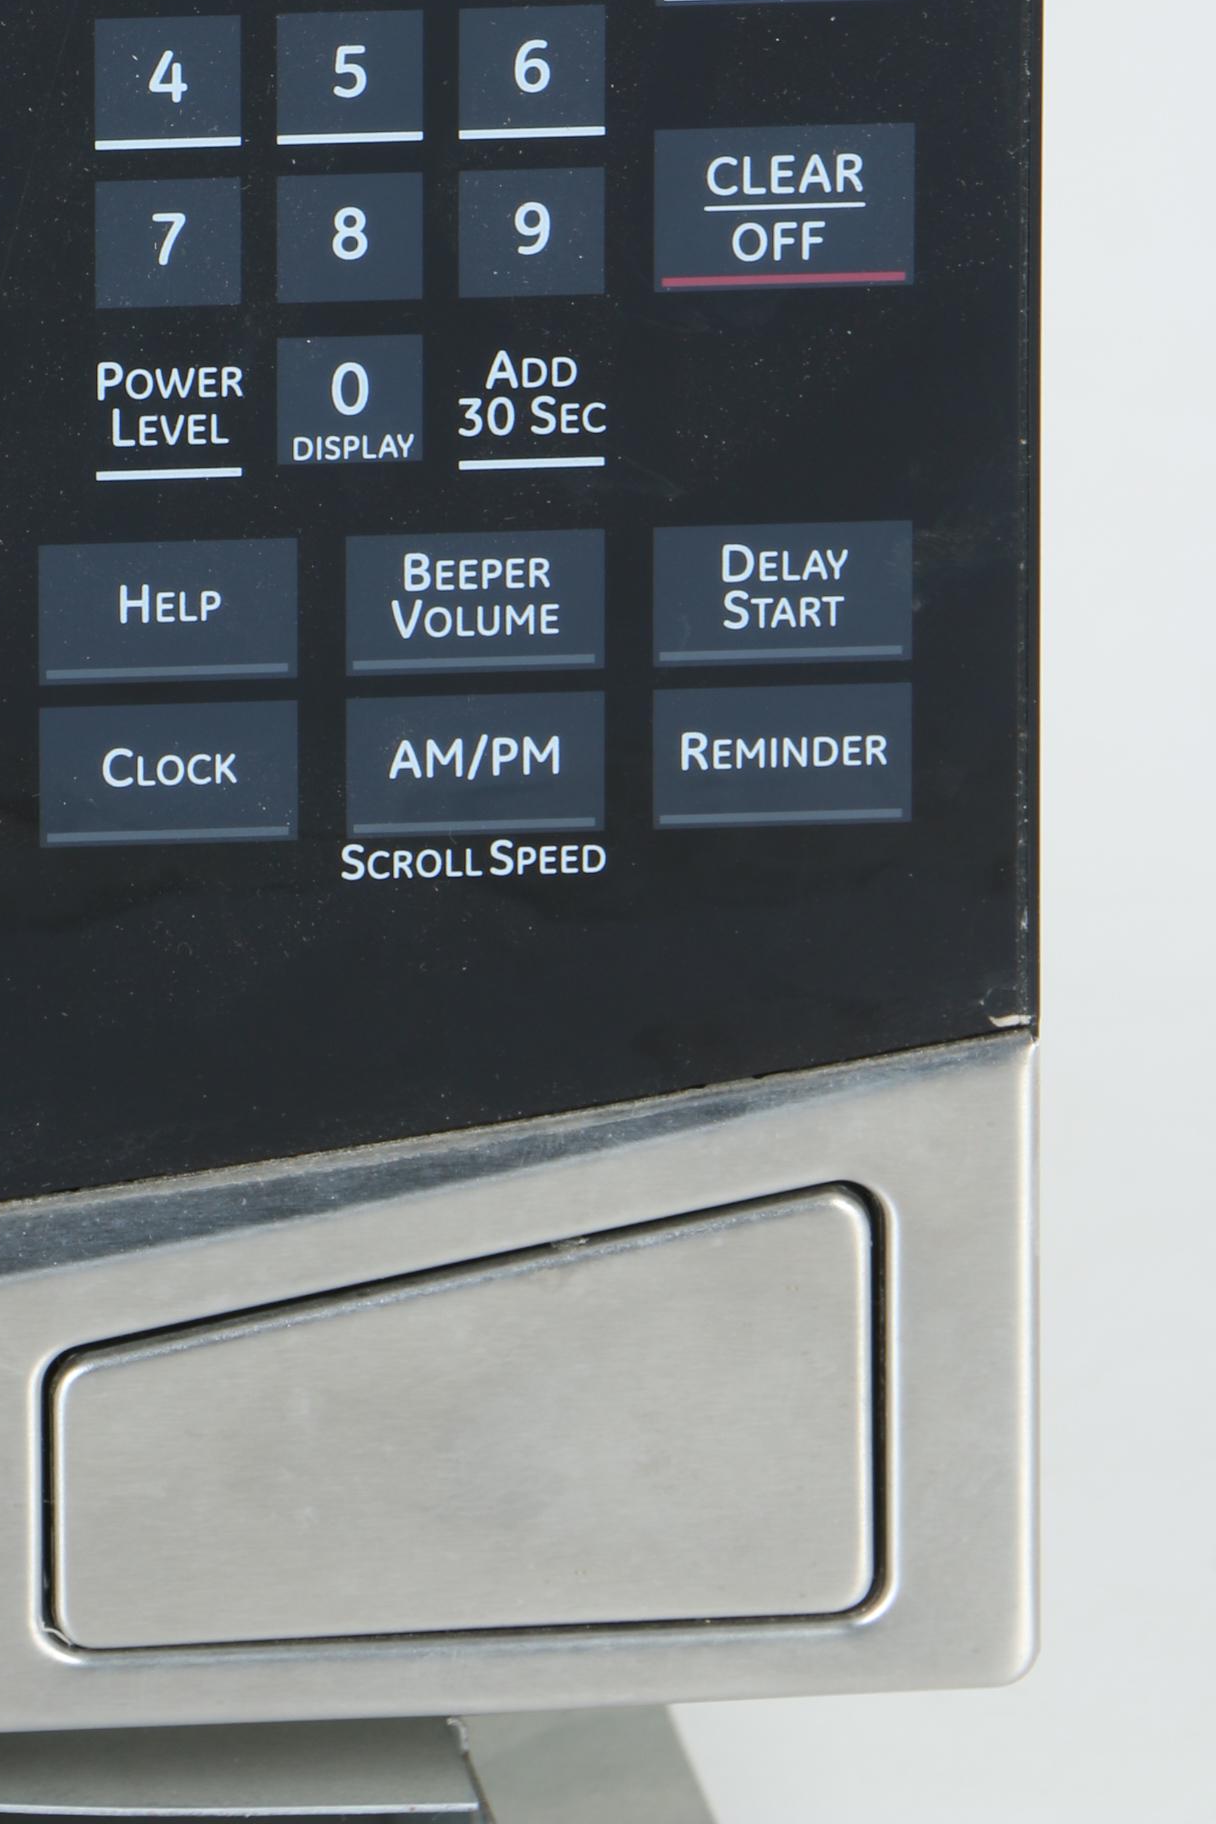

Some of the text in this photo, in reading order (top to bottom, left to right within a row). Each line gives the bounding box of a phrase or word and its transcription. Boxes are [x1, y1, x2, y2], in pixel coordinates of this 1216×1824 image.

[147, 48, 189, 105] 4
[332, 43, 368, 100] 5
[513, 37, 552, 95] 6
[705, 151, 865, 198] CLEAR
[150, 211, 188, 267] 7
[331, 205, 370, 262] 8
[513, 200, 552, 257] 9
[730, 219, 827, 263] OFF
[96, 360, 245, 402] POWER
[330, 360, 371, 417] 0
[484, 348, 579, 391] ADD
[111, 406, 231, 448] LEVEL
[457, 394, 608, 438] 30 SEC
[291, 432, 416, 463] DISPLAY
[402, 551, 552, 593] BEEPER
[720, 542, 850, 584] DELAY
[118, 582, 223, 625] HELP
[390, 597, 561, 641] VOLUME
[721, 588, 846, 631] START
[101, 746, 239, 789] CLOCK
[387, 732, 561, 782] AM/PM
[679, 730, 889, 772] REMINDER
[340, 838, 608, 882] SCROLL SPEED
